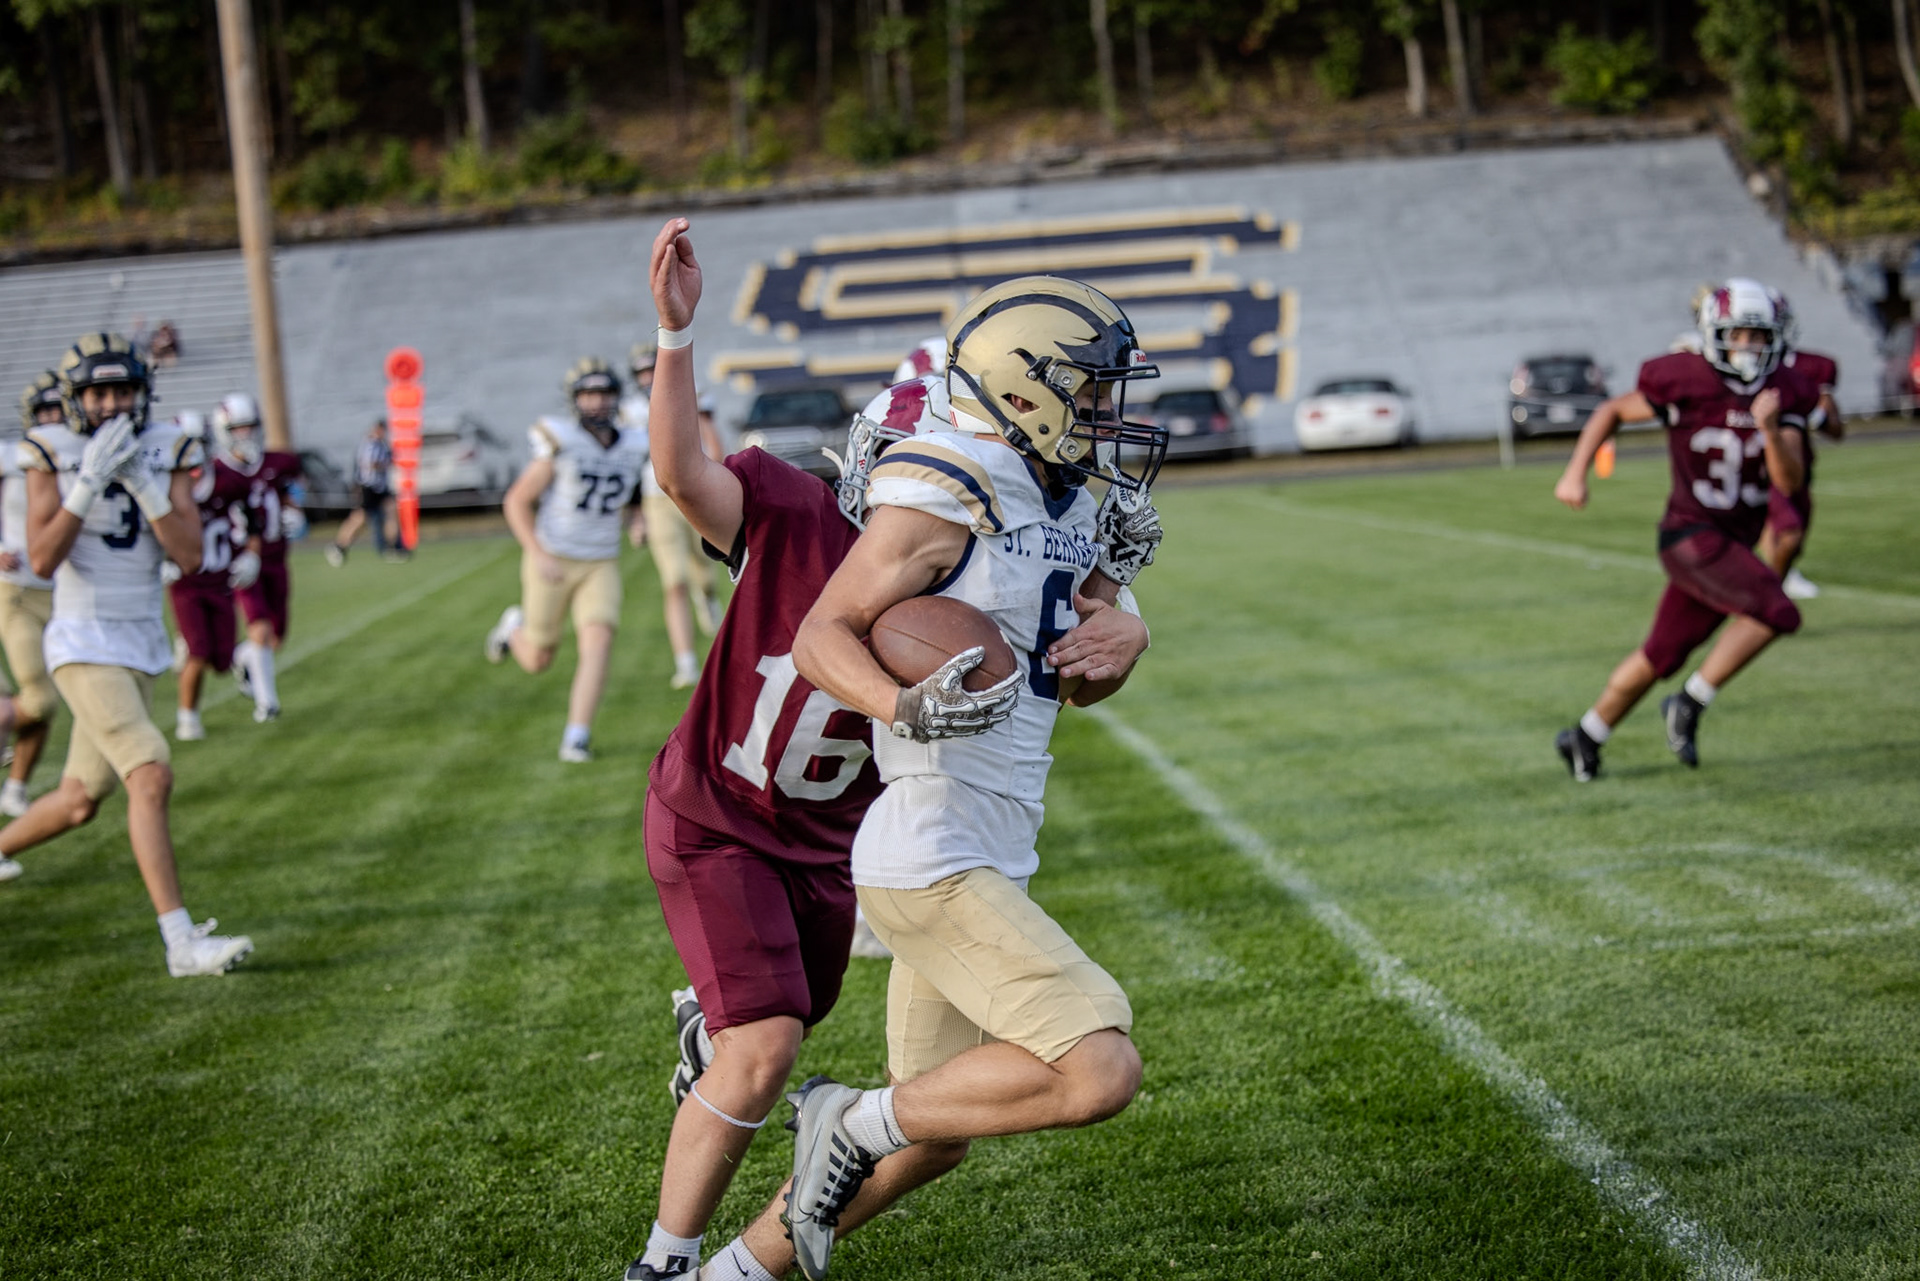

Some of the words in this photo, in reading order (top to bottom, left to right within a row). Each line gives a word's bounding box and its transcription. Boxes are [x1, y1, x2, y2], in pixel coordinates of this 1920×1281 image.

[101, 481, 140, 549] 3
[577, 473, 625, 515] 72
[1028, 569, 1075, 701] 6
[721, 652, 873, 801] 16
